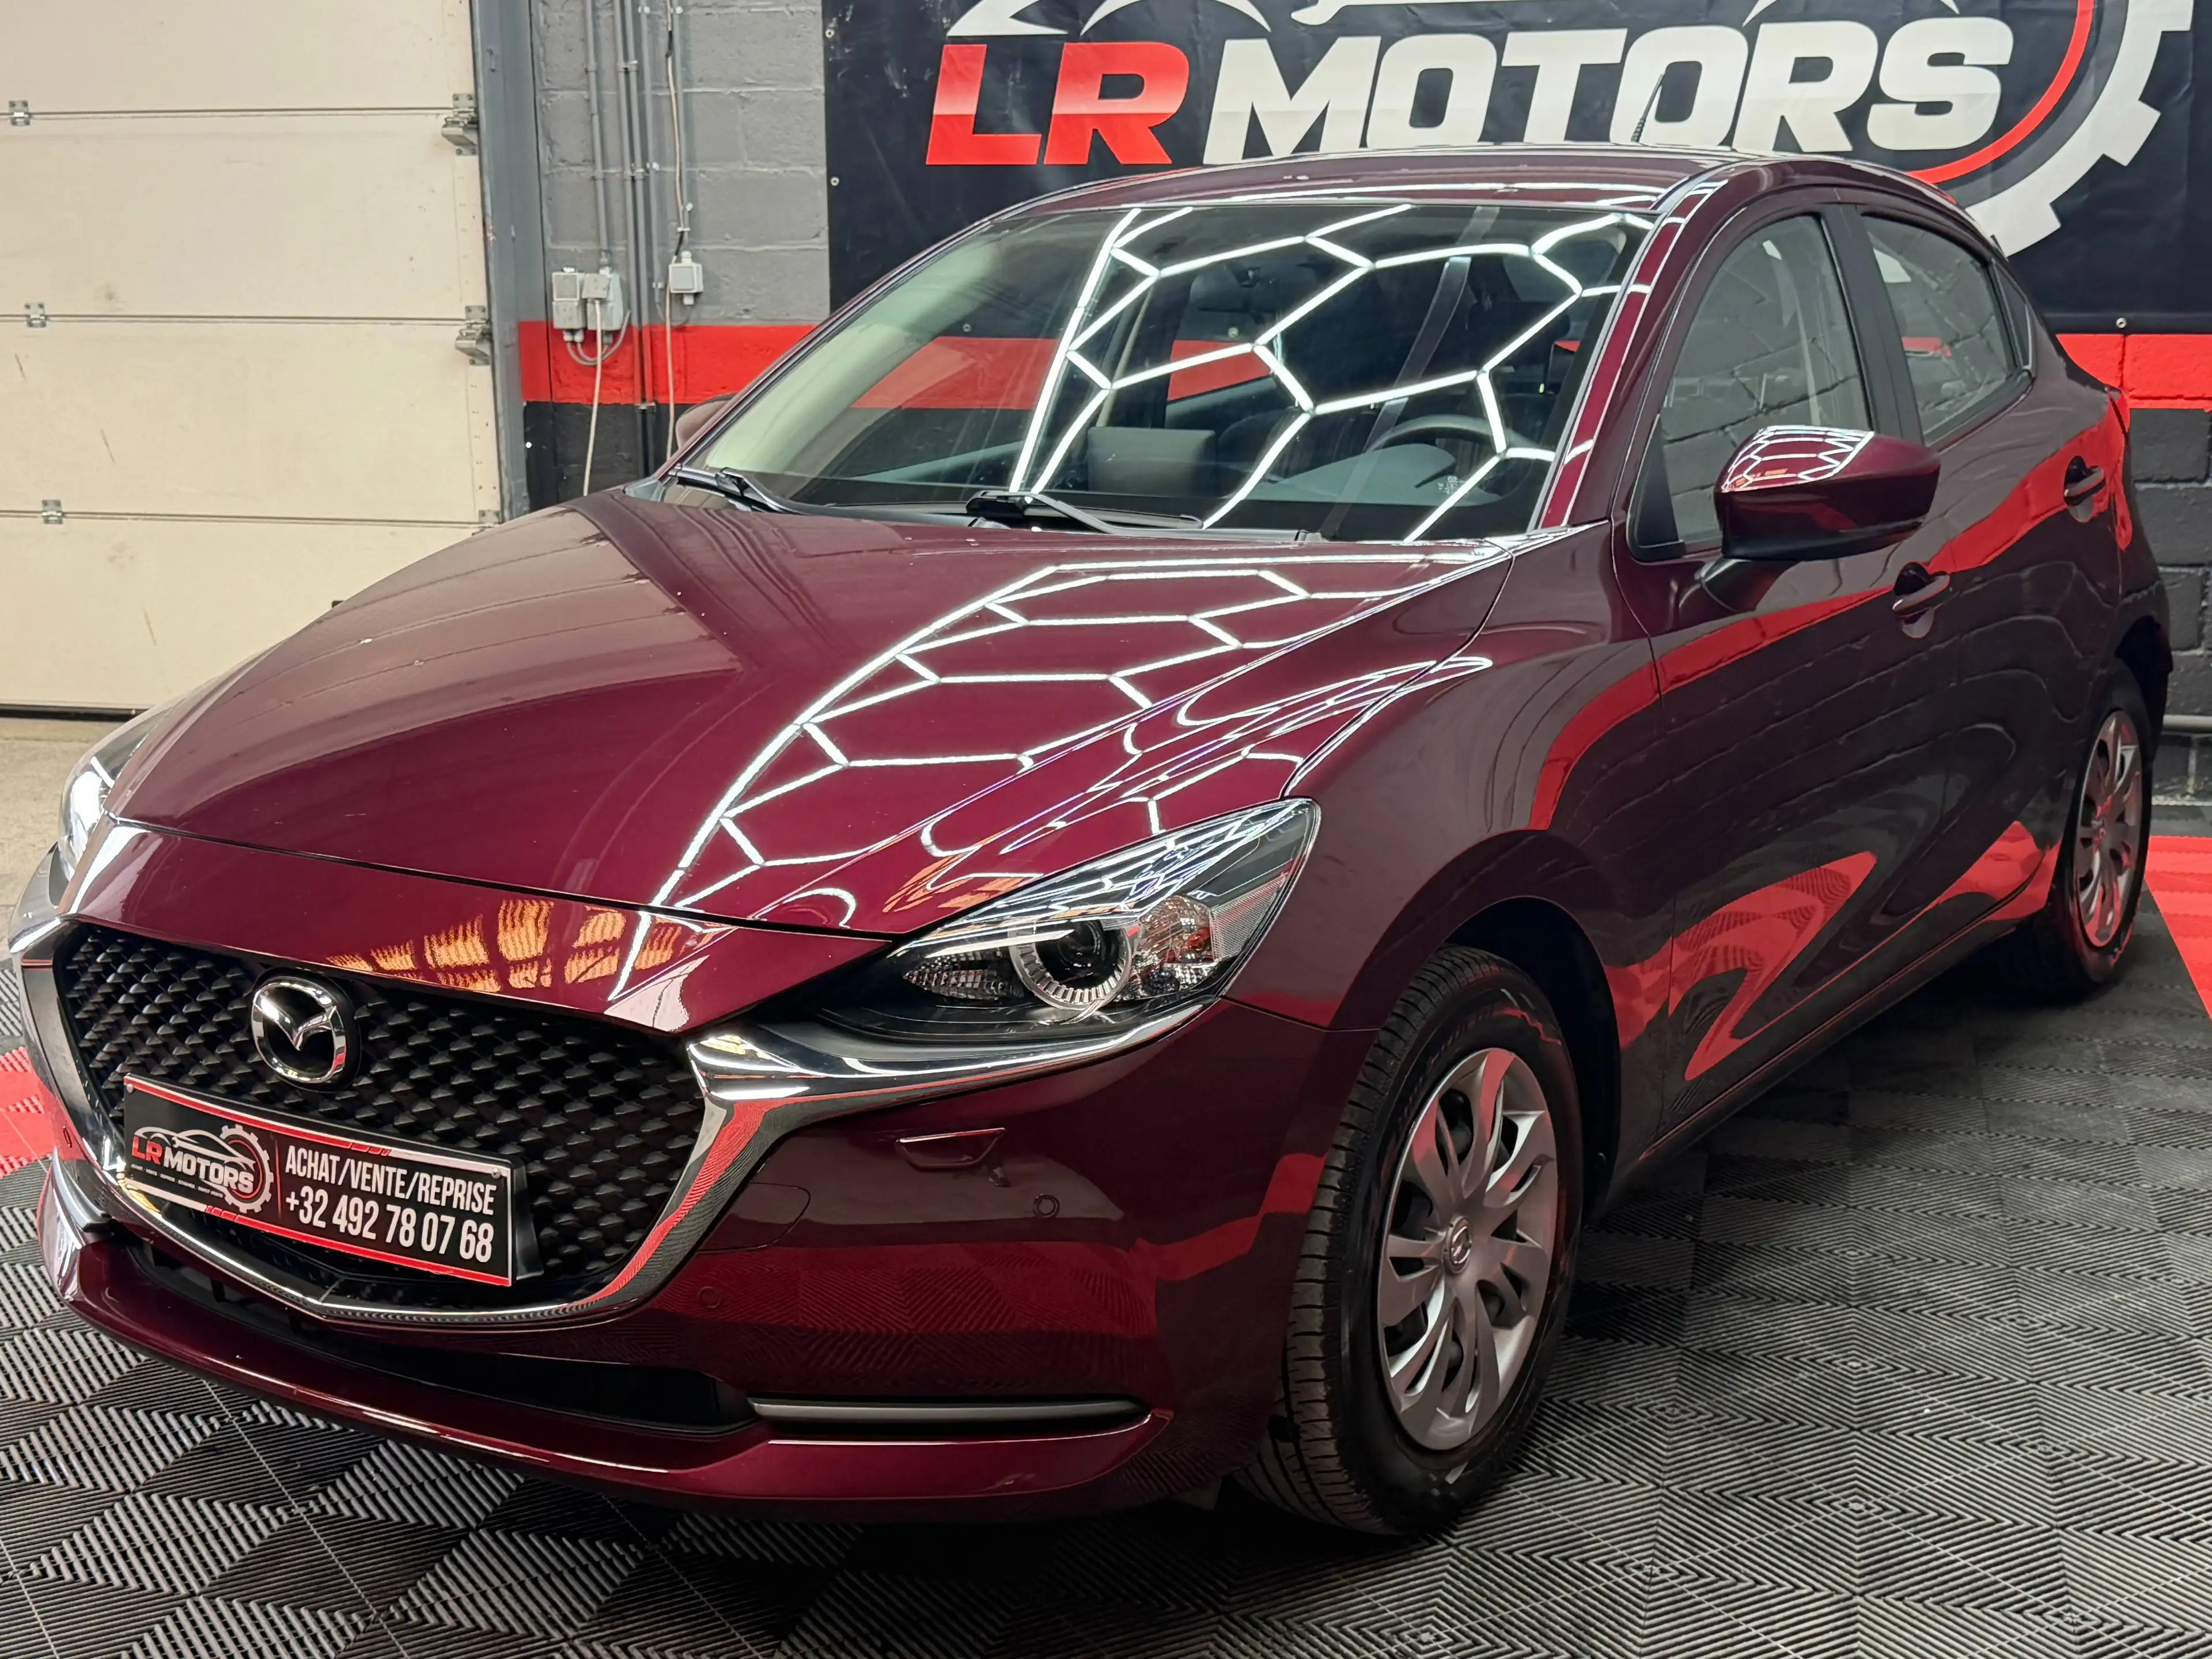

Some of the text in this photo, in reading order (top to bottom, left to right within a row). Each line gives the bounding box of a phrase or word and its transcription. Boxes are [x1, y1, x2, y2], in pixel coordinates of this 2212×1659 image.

[925, 17, 2014, 165] LR MOTORS
[131, 1135, 162, 1165] LR
[164, 1146, 255, 1194] MOTORS
[286, 1185, 494, 1263] +32 492 78 07 68
